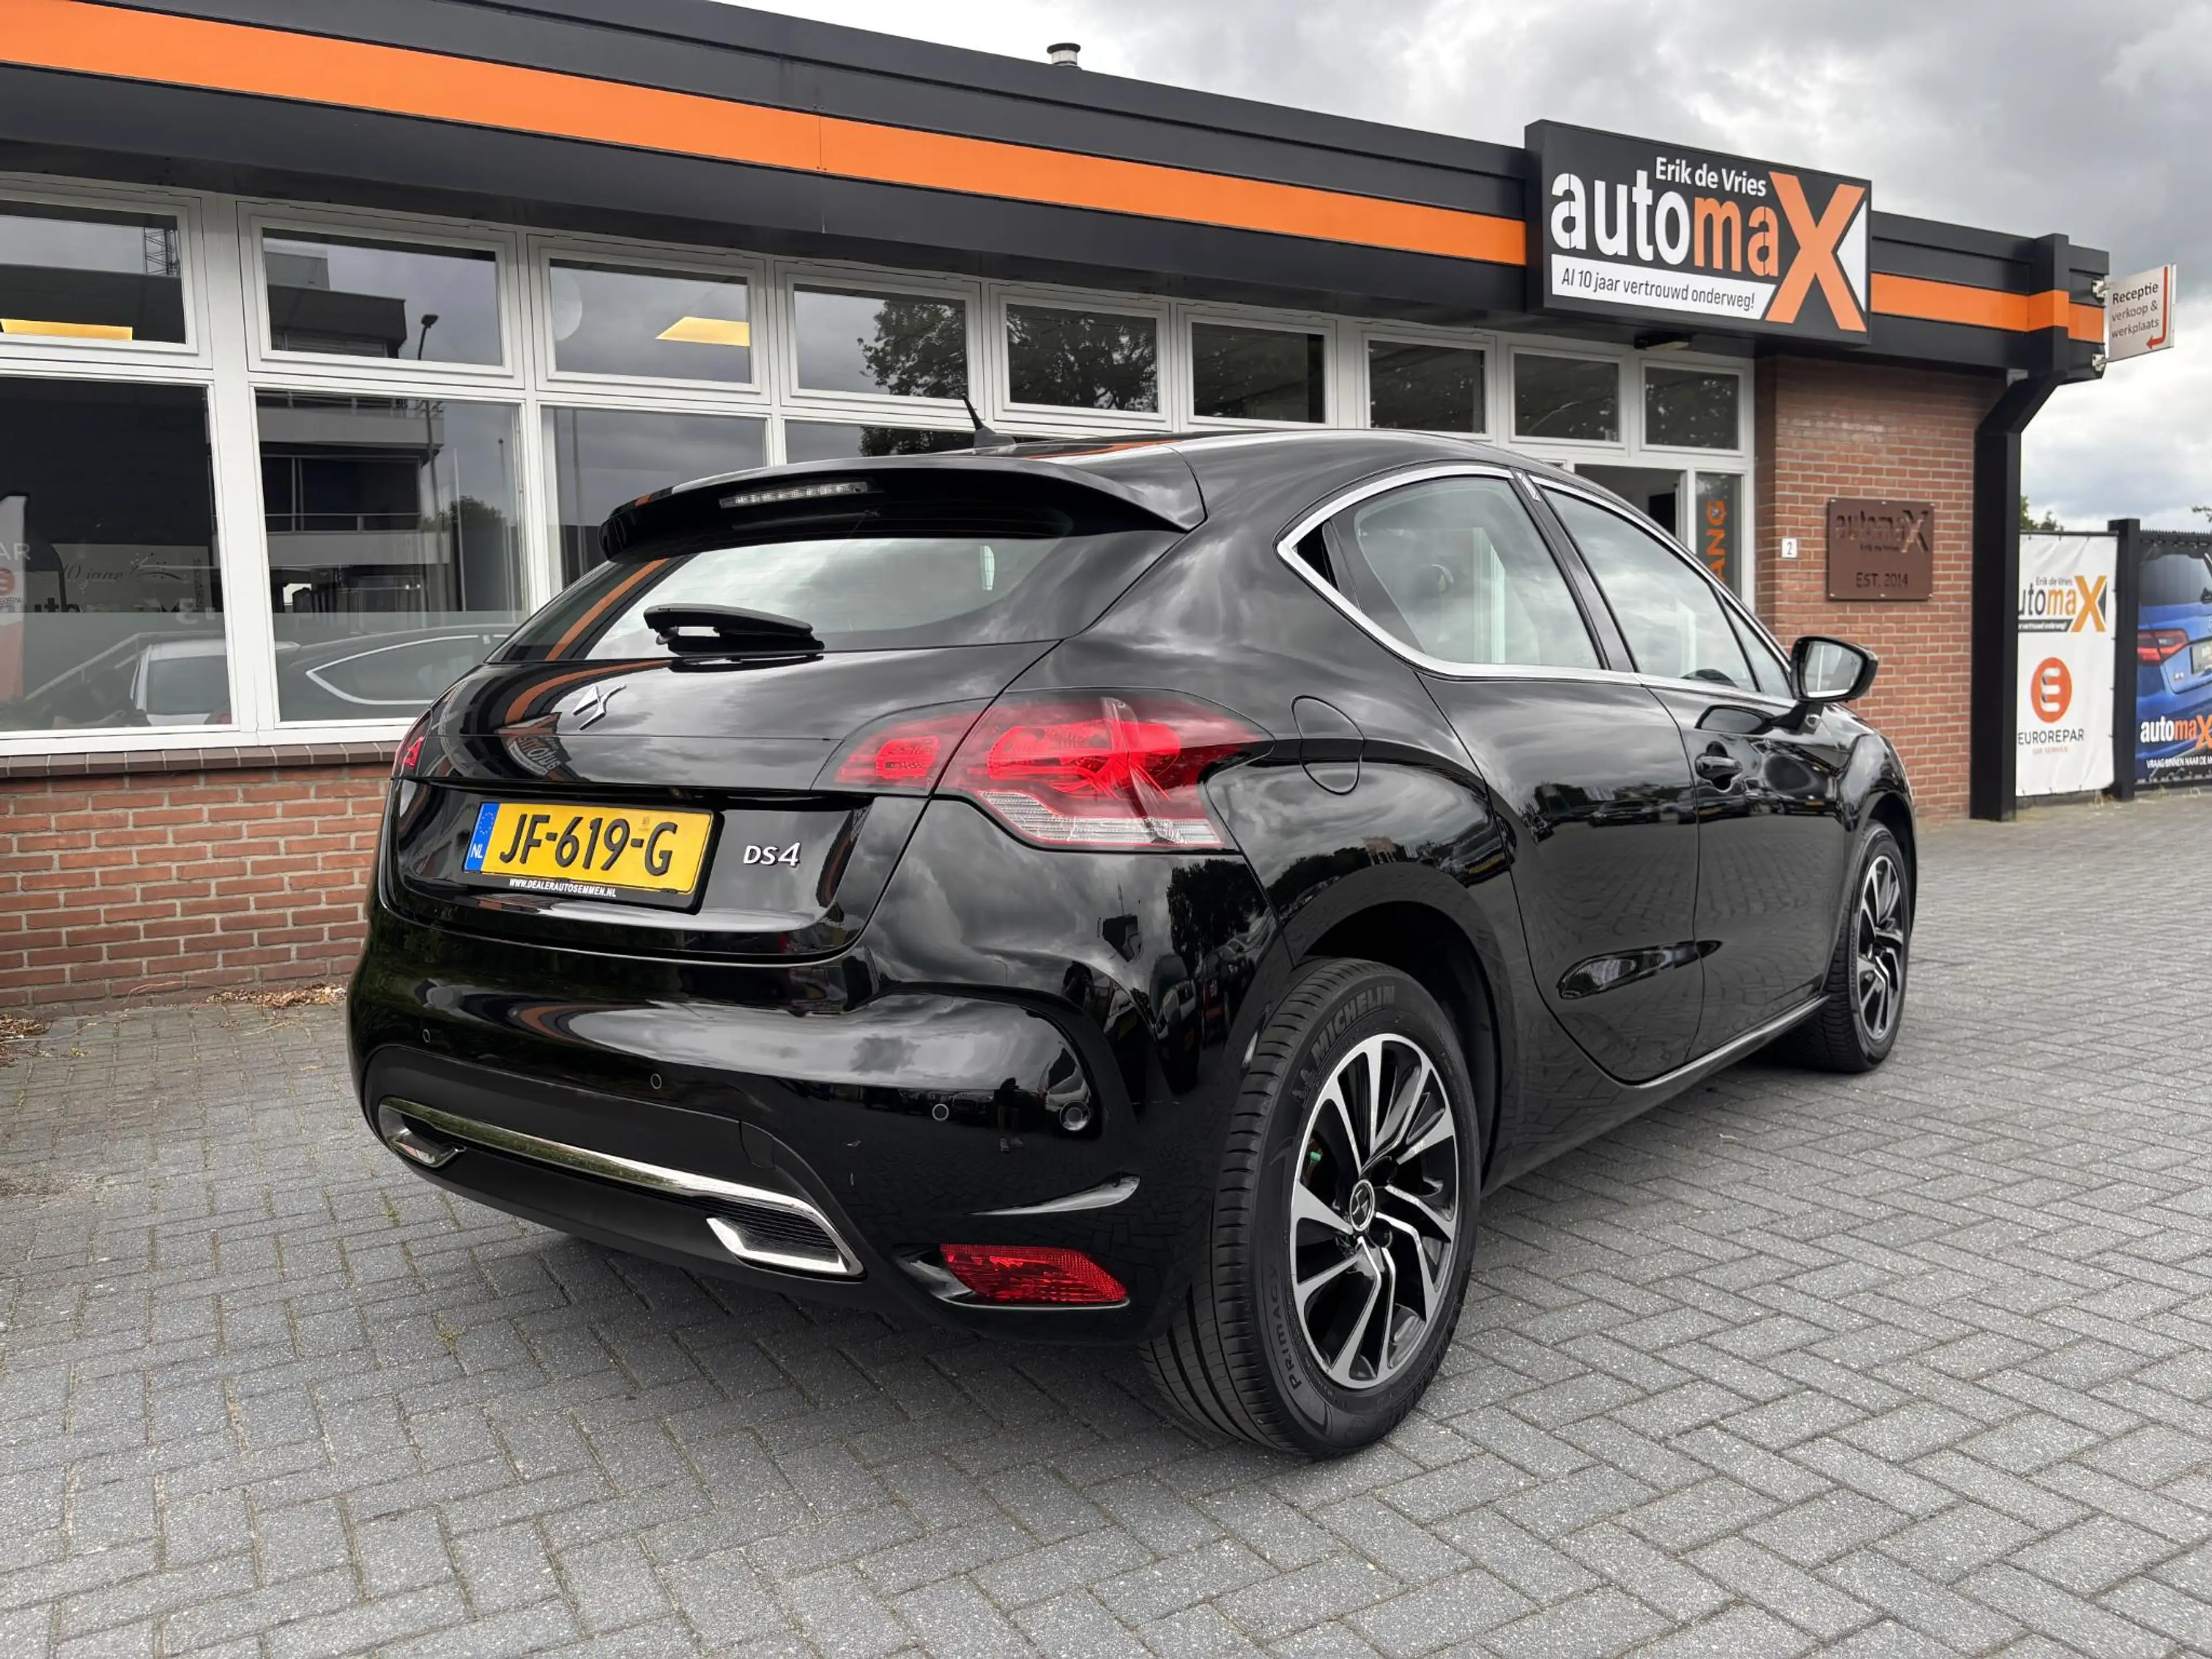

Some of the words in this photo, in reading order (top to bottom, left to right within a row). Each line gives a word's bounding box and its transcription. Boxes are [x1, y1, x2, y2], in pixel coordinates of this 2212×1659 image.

[1656, 156, 1692, 184] Erik
[1695, 163, 1718, 188] de
[1722, 168, 1767, 196] Vries
[1551, 170, 1866, 331] automaX
[1562, 267, 1574, 285] Al
[1577, 270, 1592, 288] 10
[1593, 272, 1620, 293] jaar
[1623, 281, 1688, 301] vertrouwd
[1691, 287, 1755, 311] onderweg!
[2112, 283, 2158, 305] Receptie
[2112, 303, 2149, 323] verkoop
[2150, 300, 2159, 311] &
[2112, 317, 2160, 339] werkplaats
[1787, 541, 1793, 555] 2
[1856, 572, 1881, 588] EST.
[1884, 572, 1908, 588] 2014
[2018, 575, 2108, 632] utomaX
[2018, 728, 2085, 745] EUROREPAR
[471, 843, 484, 859] NL
[499, 813, 677, 877] JF-619-G
[509, 878, 617, 897] WWW.DEALERAUTOSEMMEN.NL
[1311, 985, 1396, 1067] MICHELIN
